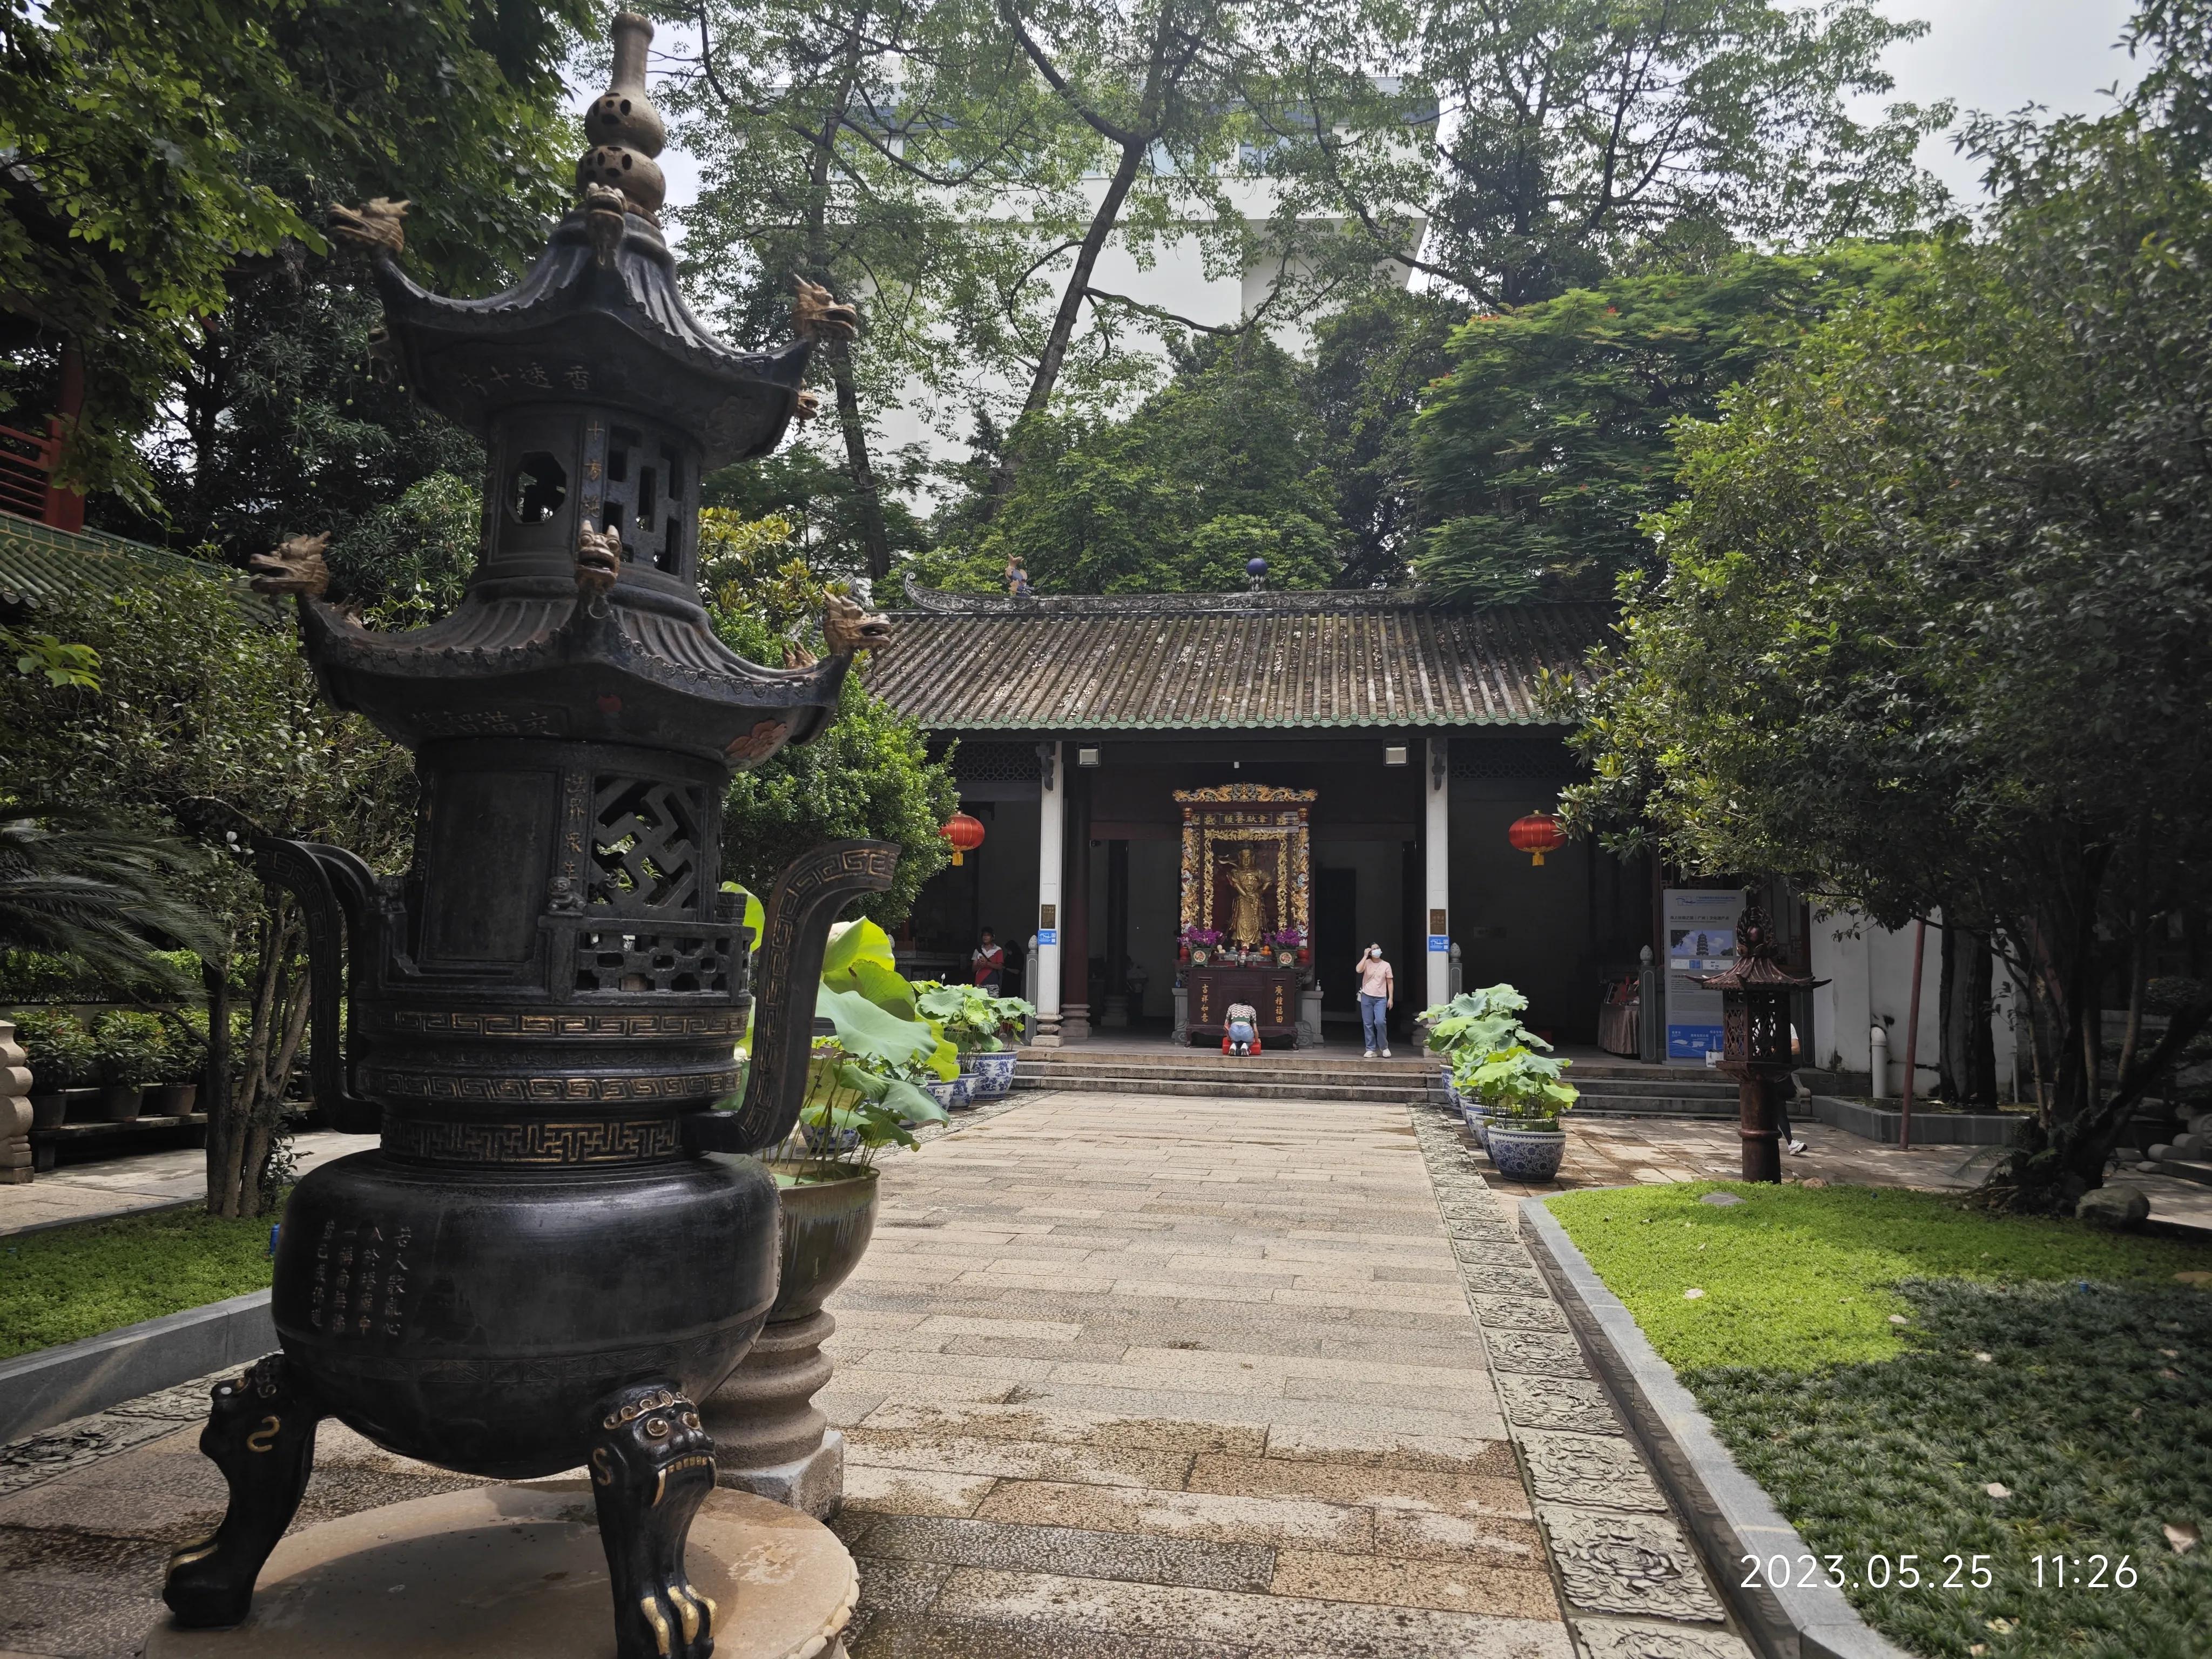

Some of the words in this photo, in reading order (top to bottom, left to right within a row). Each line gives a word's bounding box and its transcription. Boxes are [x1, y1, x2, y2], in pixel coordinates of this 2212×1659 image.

[1201, 983, 1209, 1022] 吉祥如意
[1274, 985, 1284, 1023] 廣種福田
